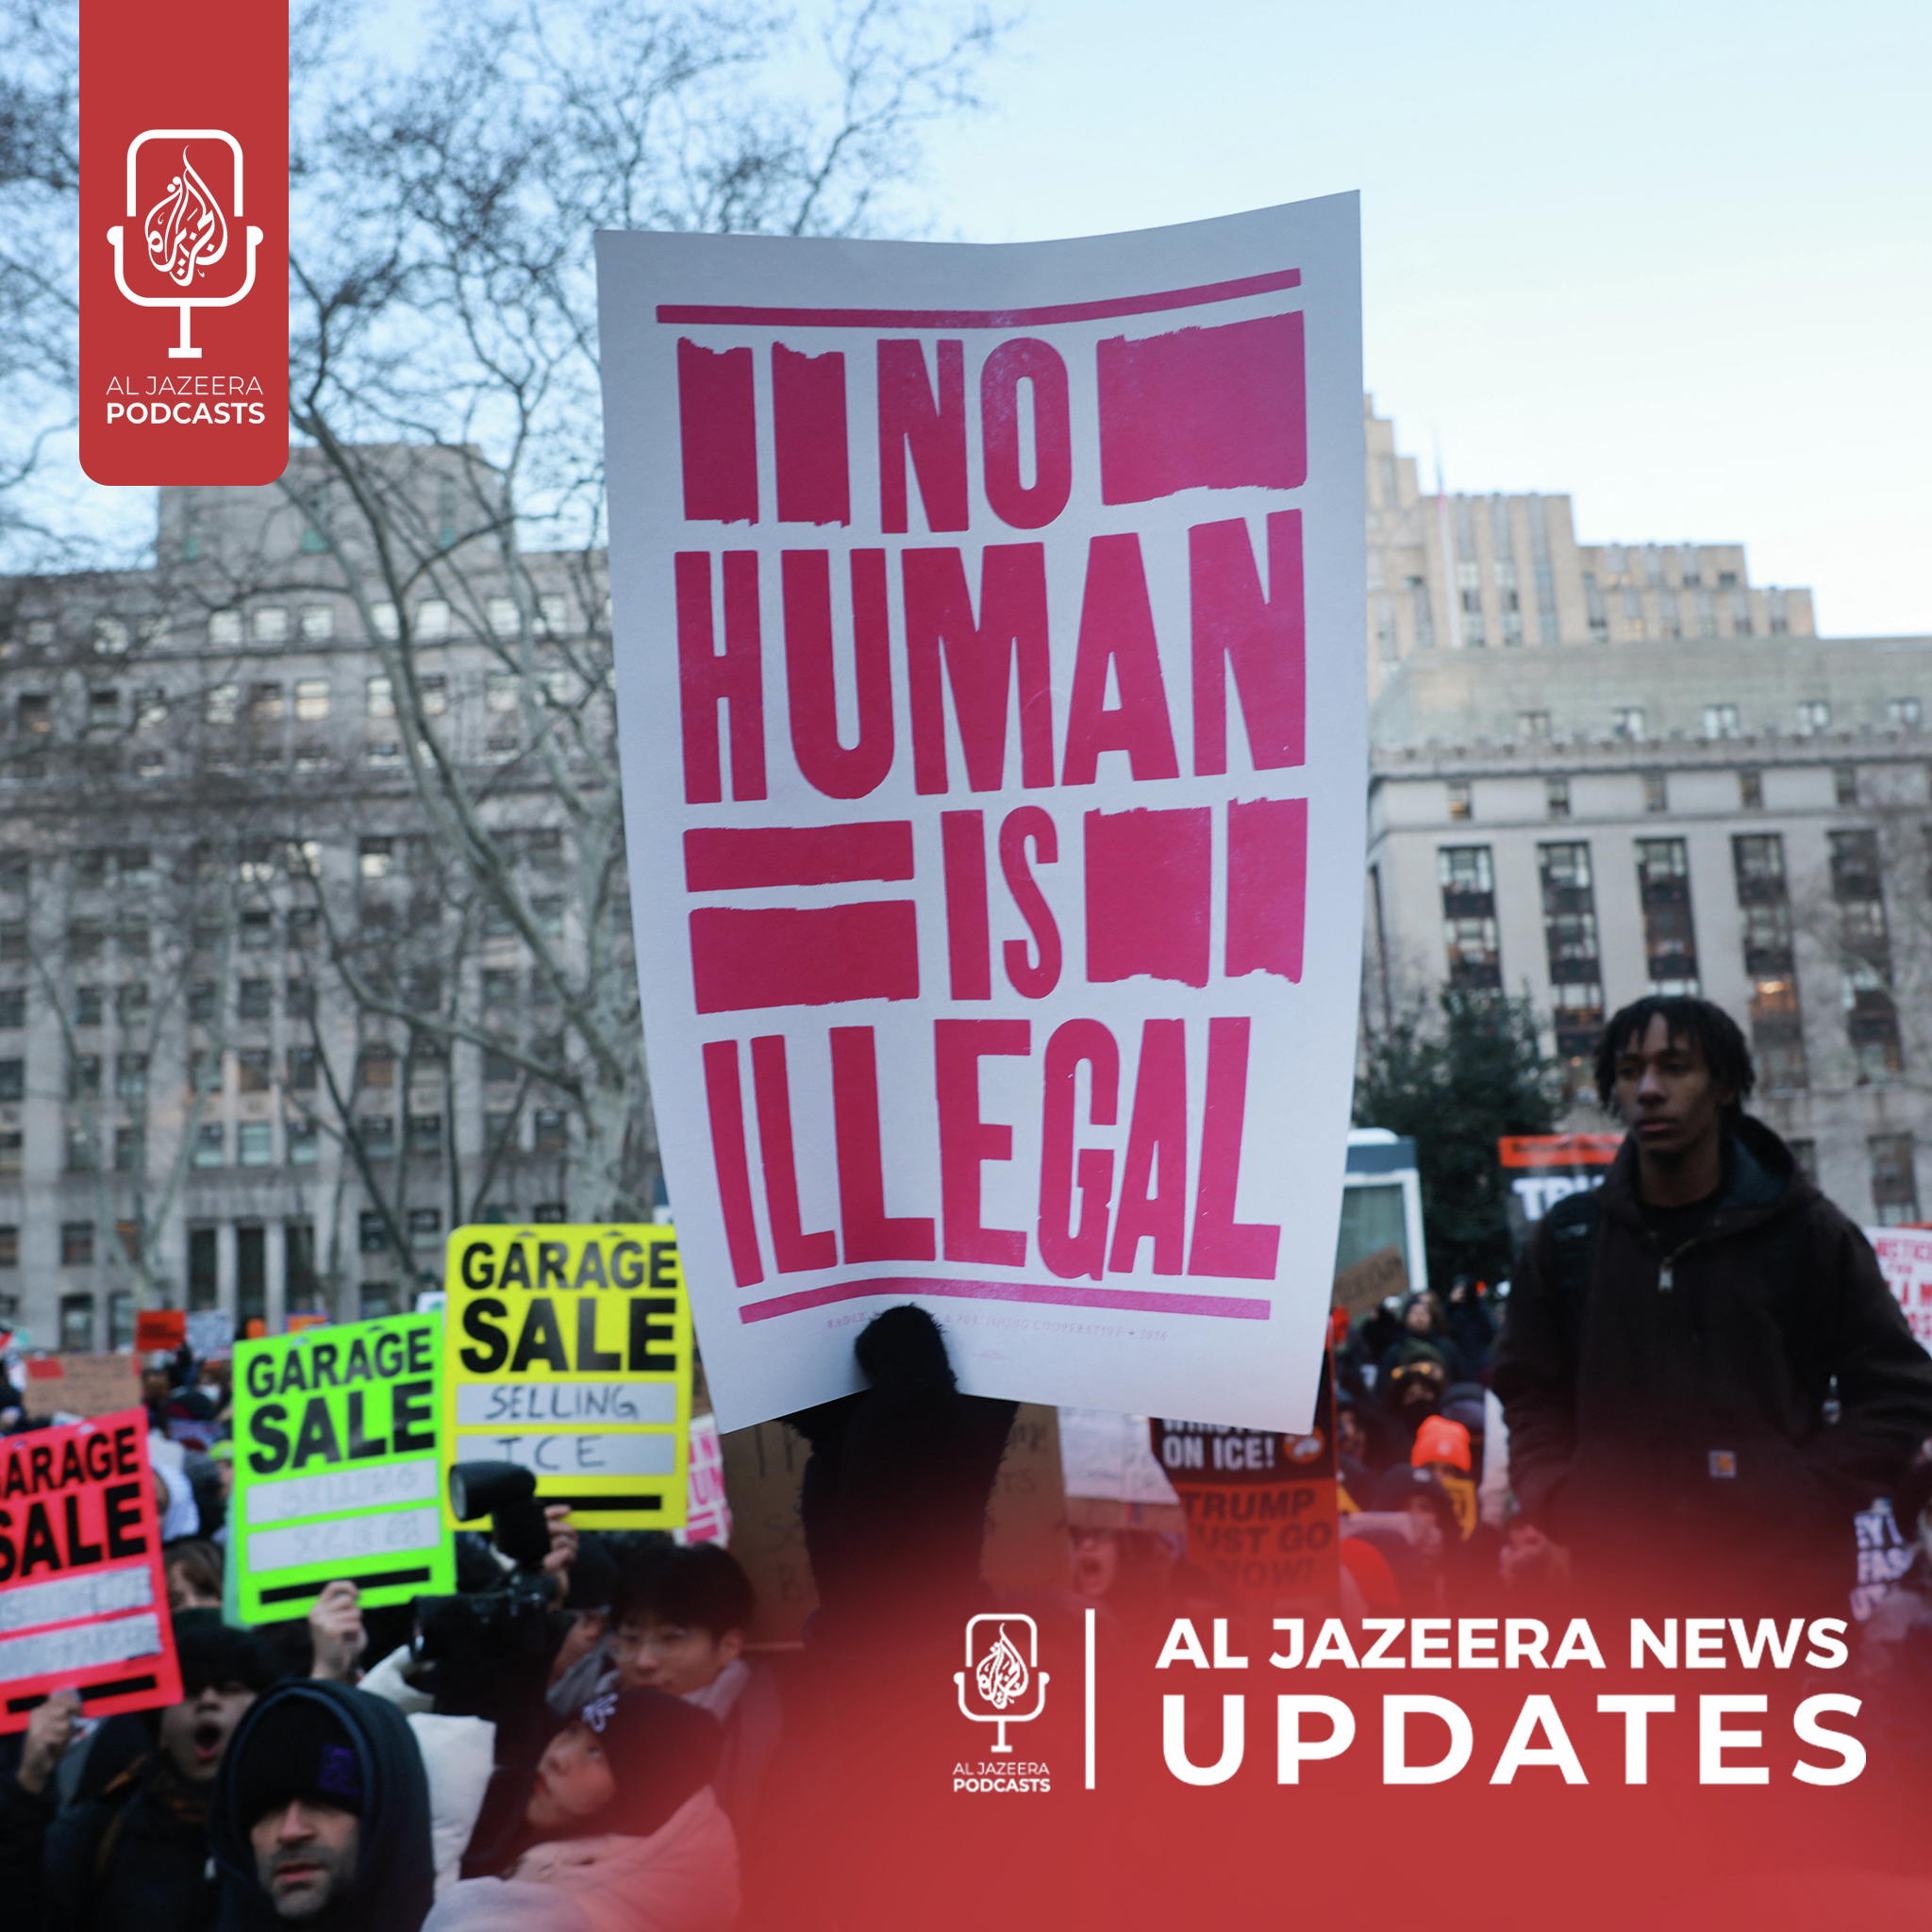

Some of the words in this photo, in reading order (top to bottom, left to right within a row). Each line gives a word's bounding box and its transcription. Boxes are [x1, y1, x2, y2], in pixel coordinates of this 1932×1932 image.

[875, 336, 1072, 534] NO
[674, 508, 1306, 804] HUMAN
[940, 806, 1063, 1001] IS
[701, 1016, 1281, 1288] ILLEGAL
[460, 1241, 678, 1291] GARAGE
[246, 1326, 434, 1399] GARAGE
[459, 1297, 677, 1374] SALE
[1033, 1320, 1124, 1338] COOPERATIVE
[248, 1379, 436, 1475] SALE
[485, 1384, 640, 1421] SELLING
[3, 1426, 139, 1500] ARAGE
[495, 1434, 607, 1471] ICE
[1163, 1435, 1204, 1469] ON
[1213, 1436, 1274, 1471] ICE!
[1179, 1488, 1318, 1521] TRUMP
[1194, 1524, 1270, 1556] UST
[1277, 1520, 1334, 1554] GO
